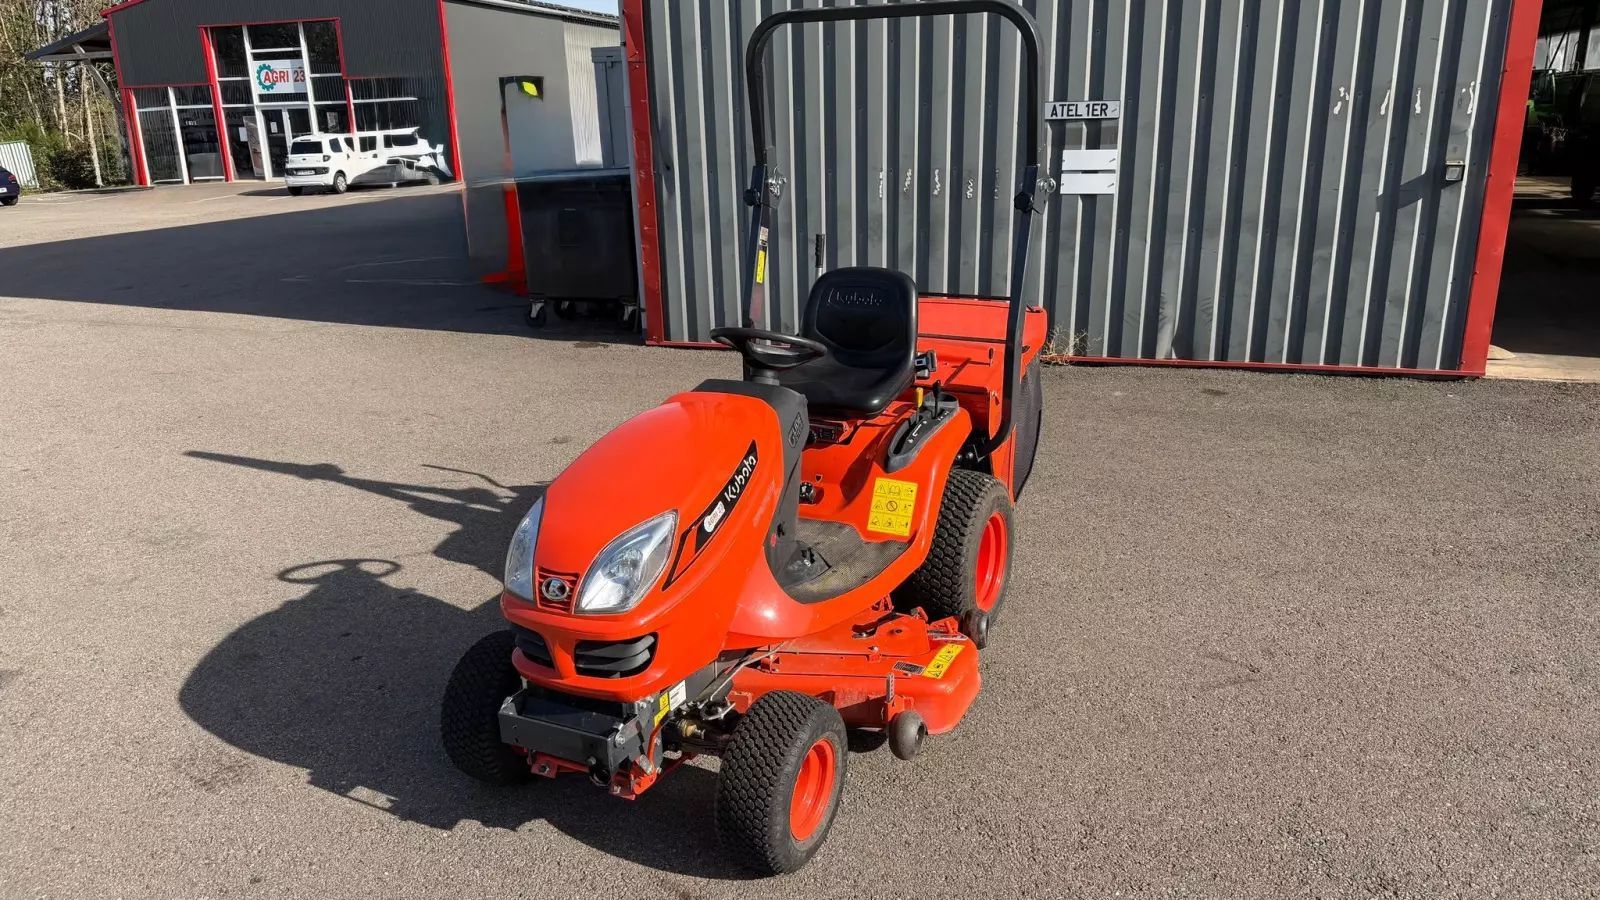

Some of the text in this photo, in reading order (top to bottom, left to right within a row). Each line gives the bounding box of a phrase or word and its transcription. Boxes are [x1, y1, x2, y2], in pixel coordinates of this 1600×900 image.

[263, 70, 306, 83] AGRI 23
[724, 455, 757, 501] Kubota
